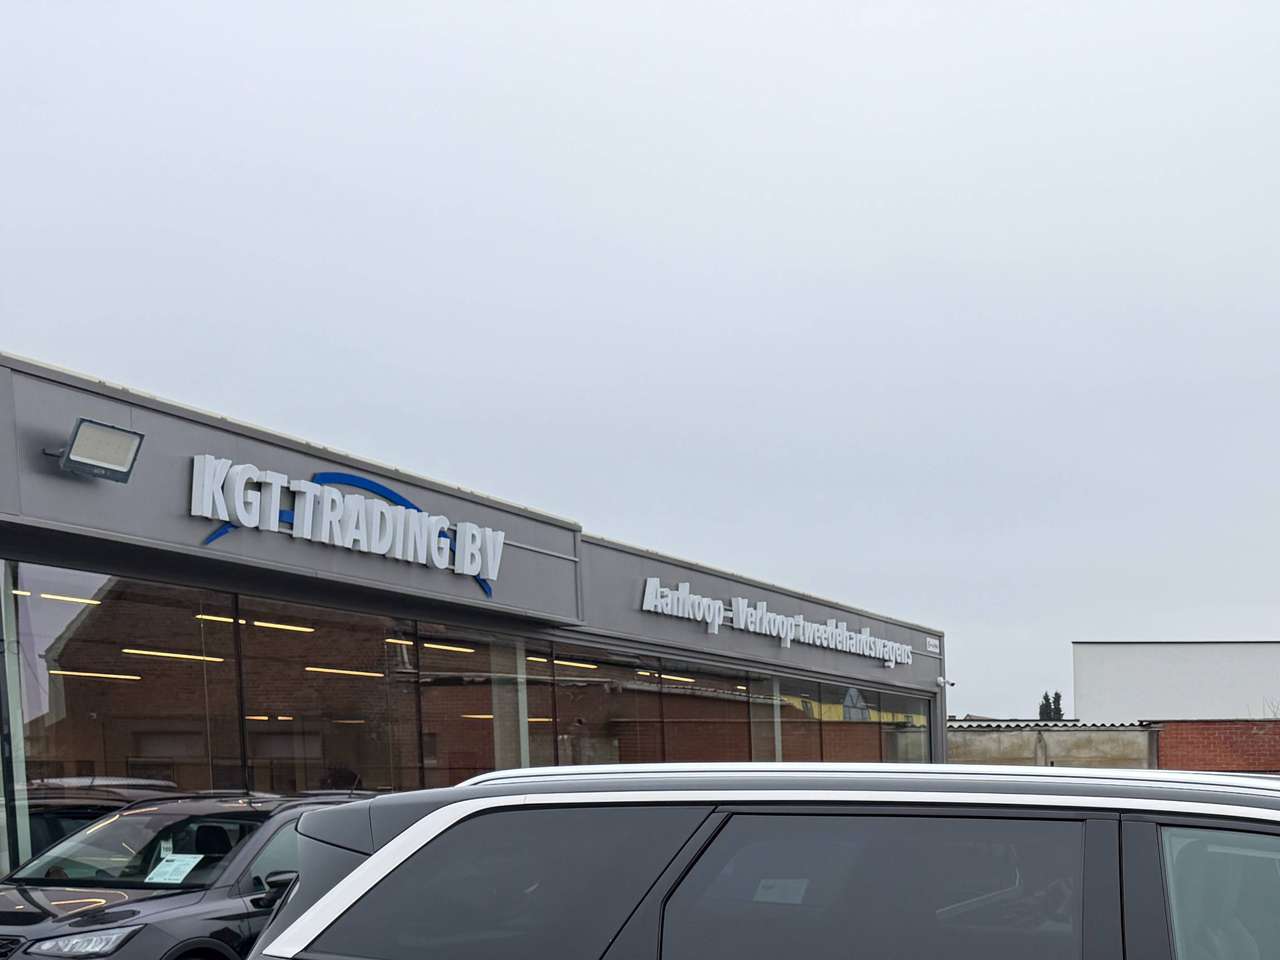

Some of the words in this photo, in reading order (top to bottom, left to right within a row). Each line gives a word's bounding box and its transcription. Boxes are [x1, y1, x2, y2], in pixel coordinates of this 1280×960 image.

[191, 453, 288, 532] KGT
[290, 479, 451, 569] TRADING
[454, 521, 505, 581] BV
[642, 577, 723, 634] Aankoop
[731, 597, 795, 649] Verkoop
